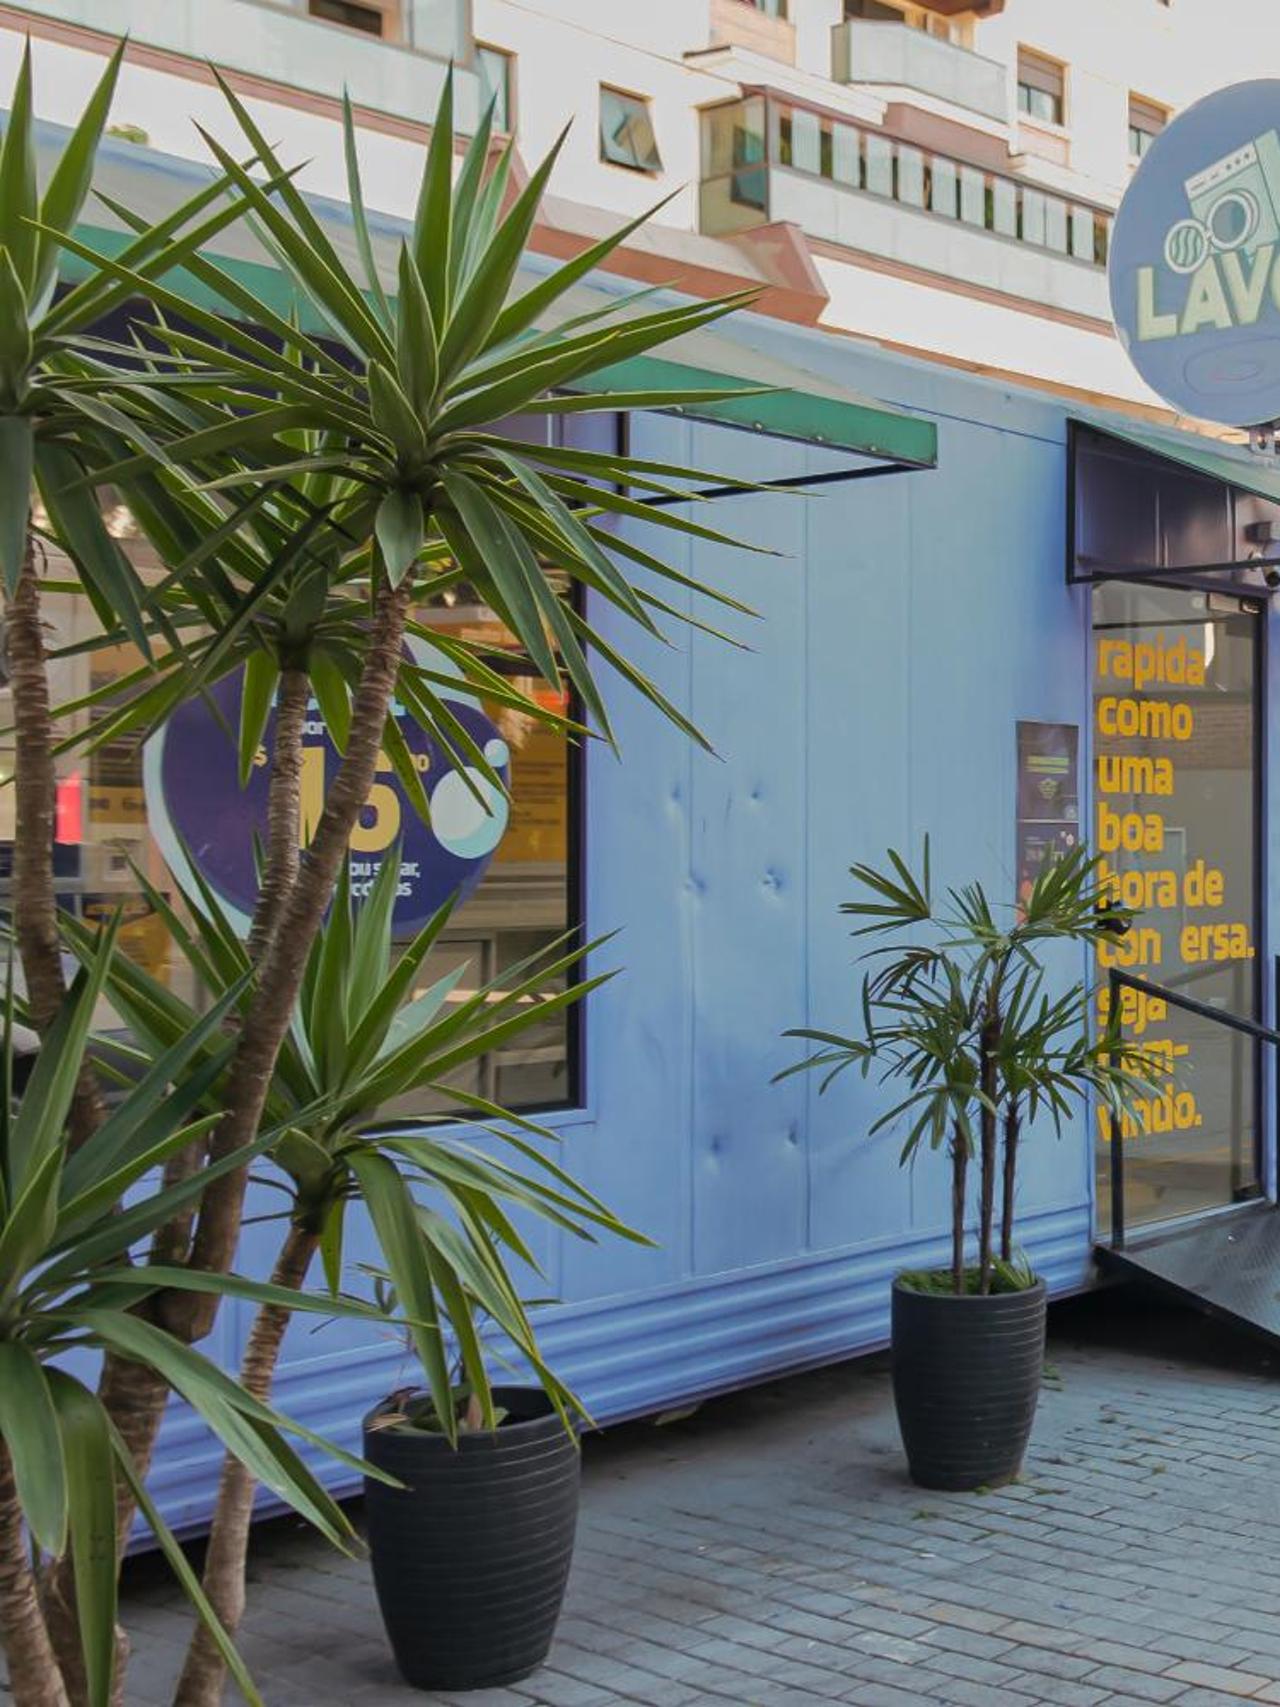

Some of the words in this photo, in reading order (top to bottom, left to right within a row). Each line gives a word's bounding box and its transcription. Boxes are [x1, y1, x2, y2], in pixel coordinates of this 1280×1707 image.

[1096, 697, 1193, 741] como
[1097, 755, 1174, 795] uma
[1097, 802, 1164, 852] boa
[1097, 859, 1177, 909] hora
[1183, 859, 1225, 907] de
